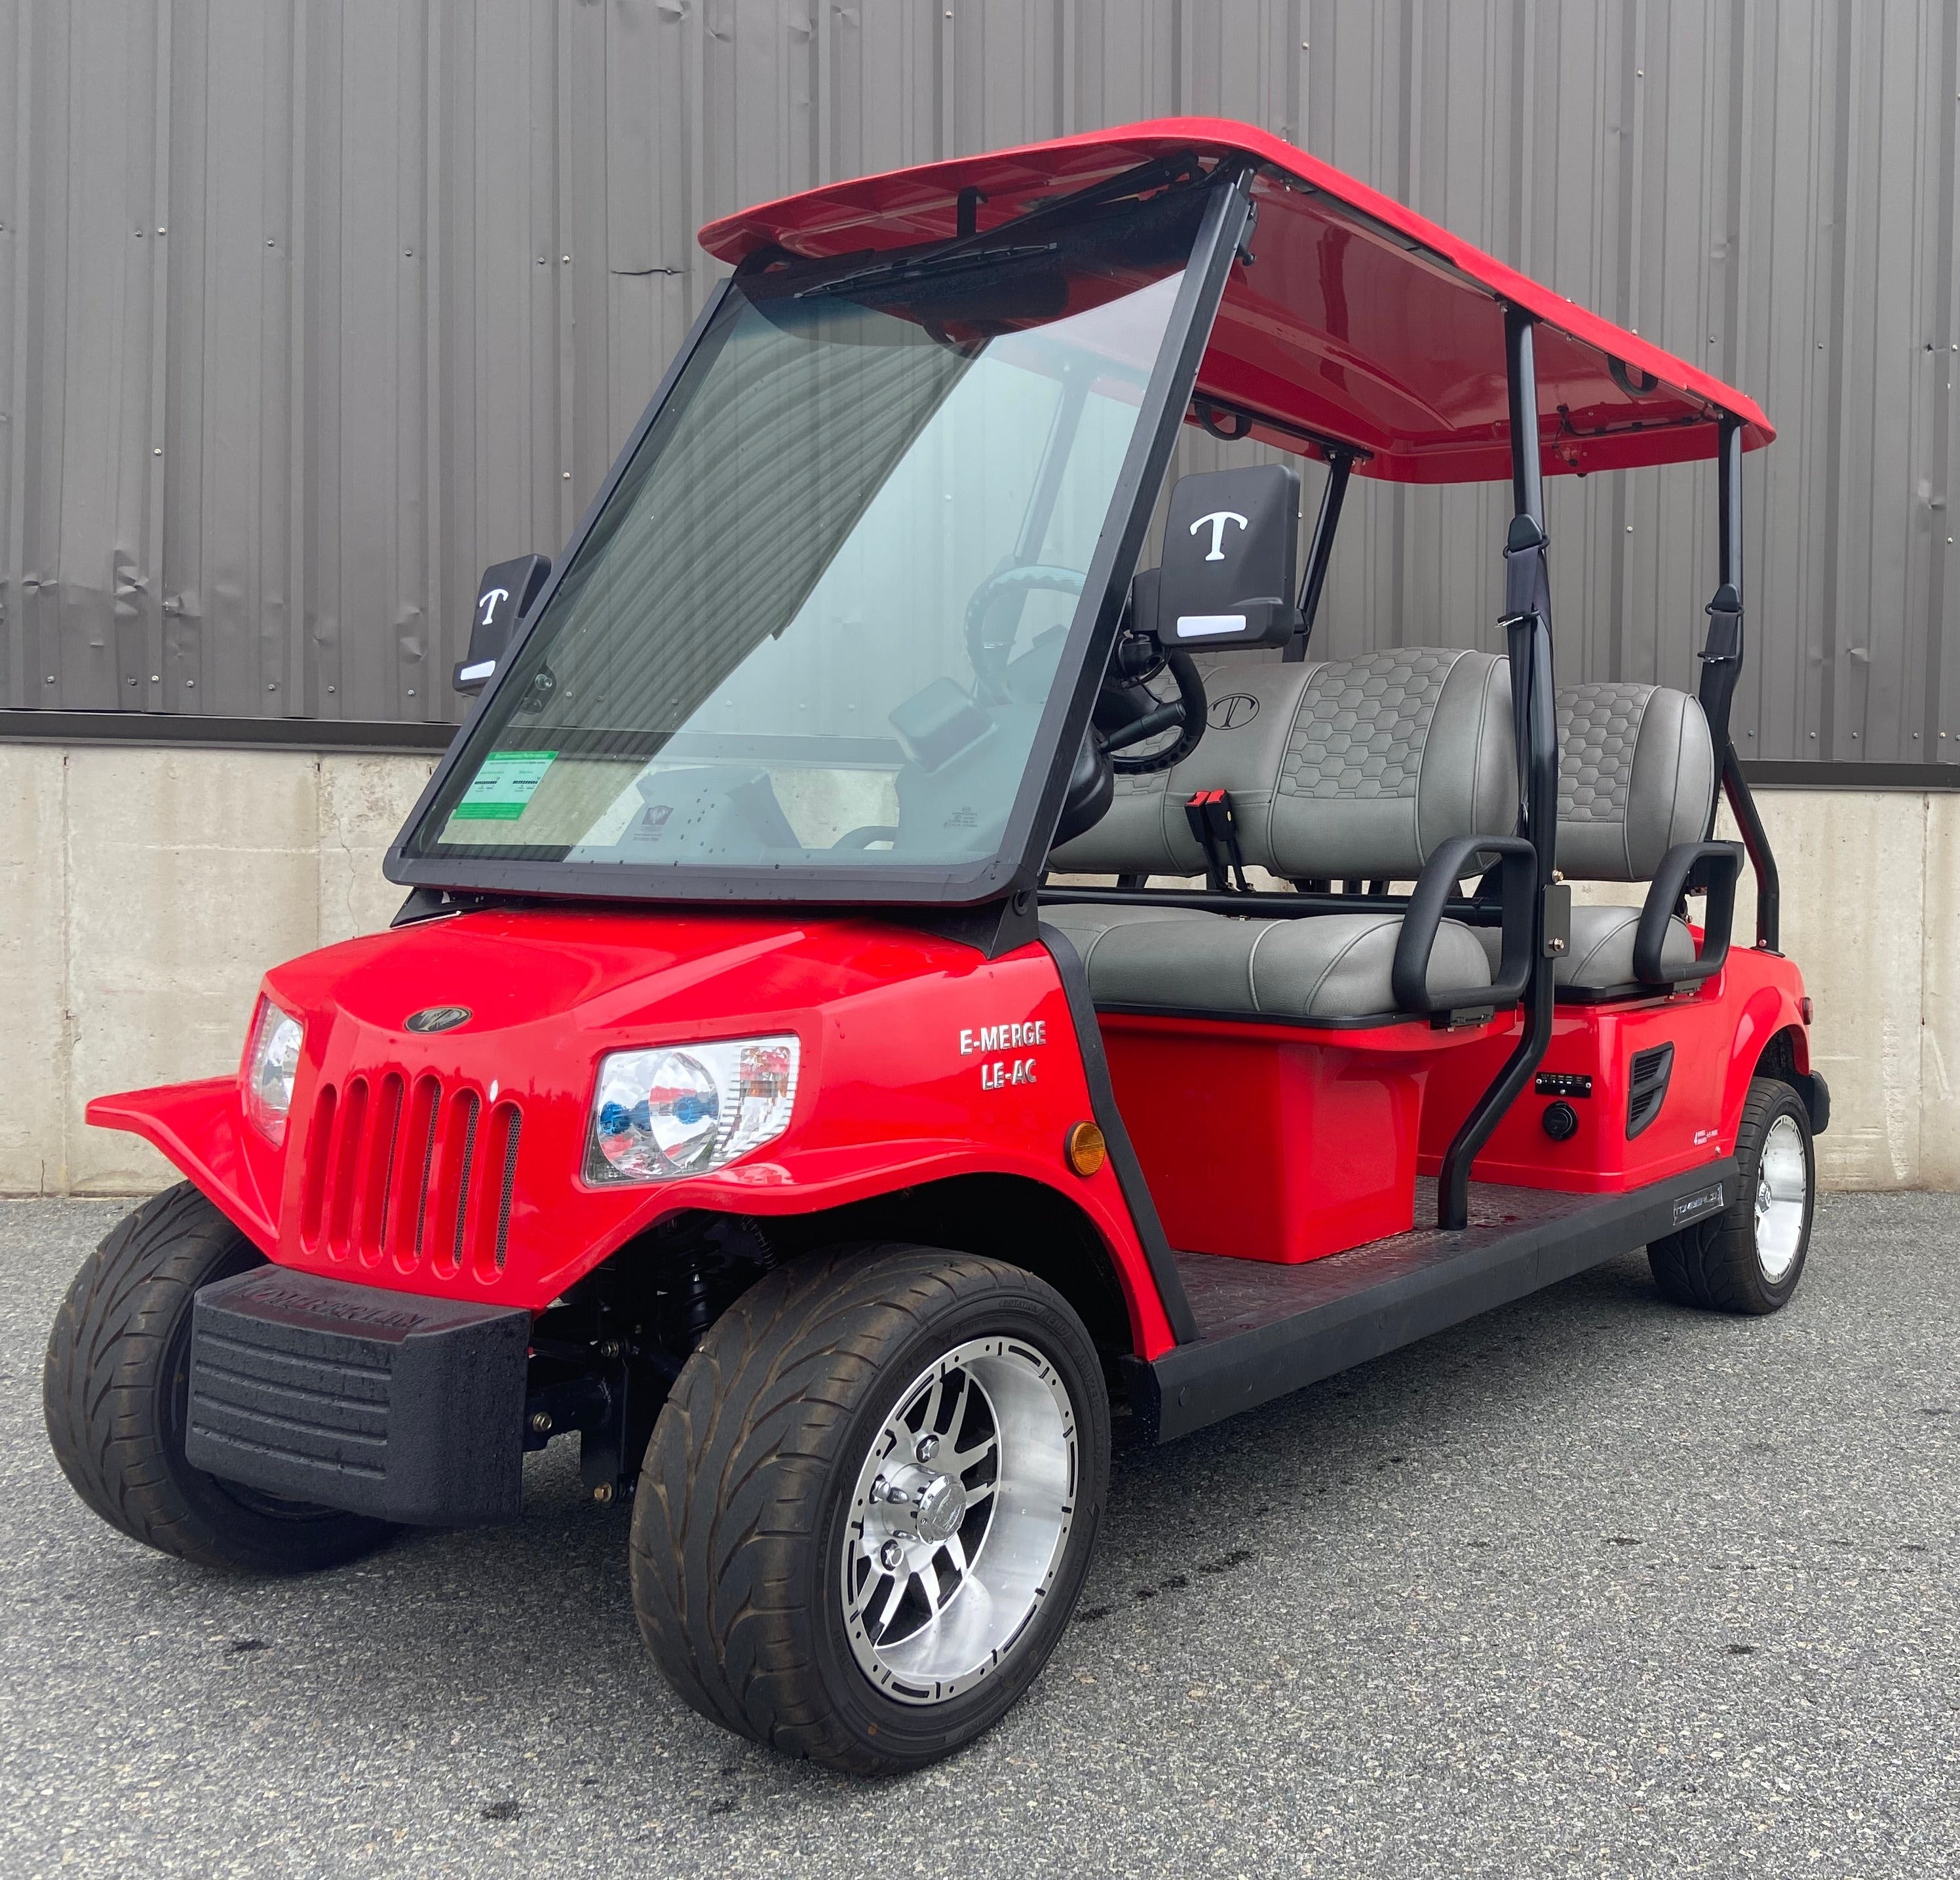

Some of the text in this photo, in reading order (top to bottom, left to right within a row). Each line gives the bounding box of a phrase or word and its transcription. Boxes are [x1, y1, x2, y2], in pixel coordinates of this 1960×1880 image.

[1189, 510, 1248, 562] T
[479, 588, 509, 626] T
[1213, 695, 1256, 728] T
[959, 1020, 1047, 1056] E-MERGE
[981, 1058, 1037, 1091] LE-AC
